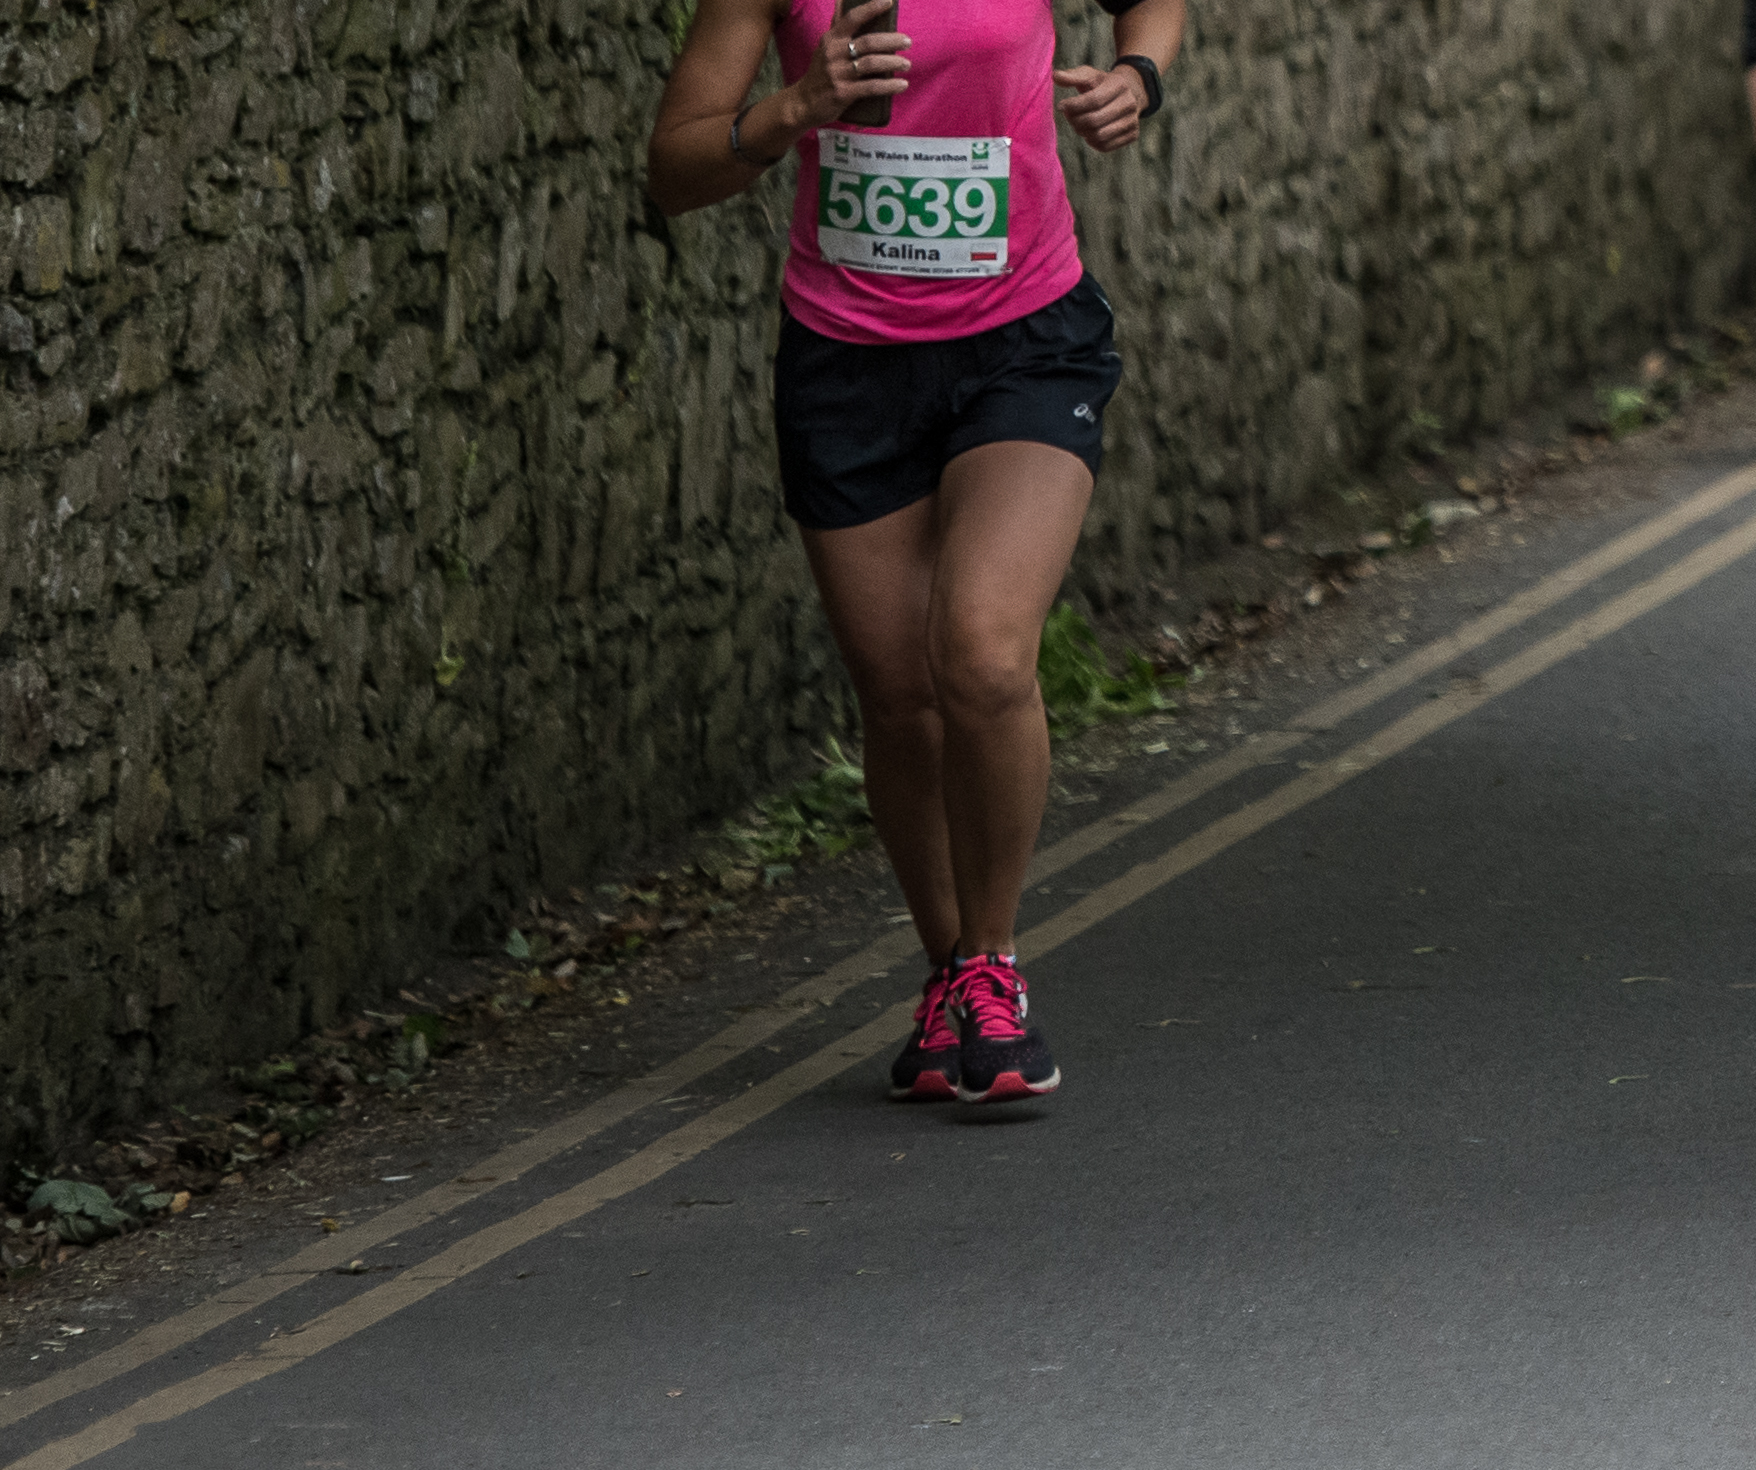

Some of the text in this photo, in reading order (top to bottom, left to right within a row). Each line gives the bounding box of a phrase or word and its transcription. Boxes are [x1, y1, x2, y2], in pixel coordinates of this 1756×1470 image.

[853, 148, 968, 162] The Wales Marathon
[827, 170, 996, 237] 5639
[872, 241, 941, 261] Kalina
